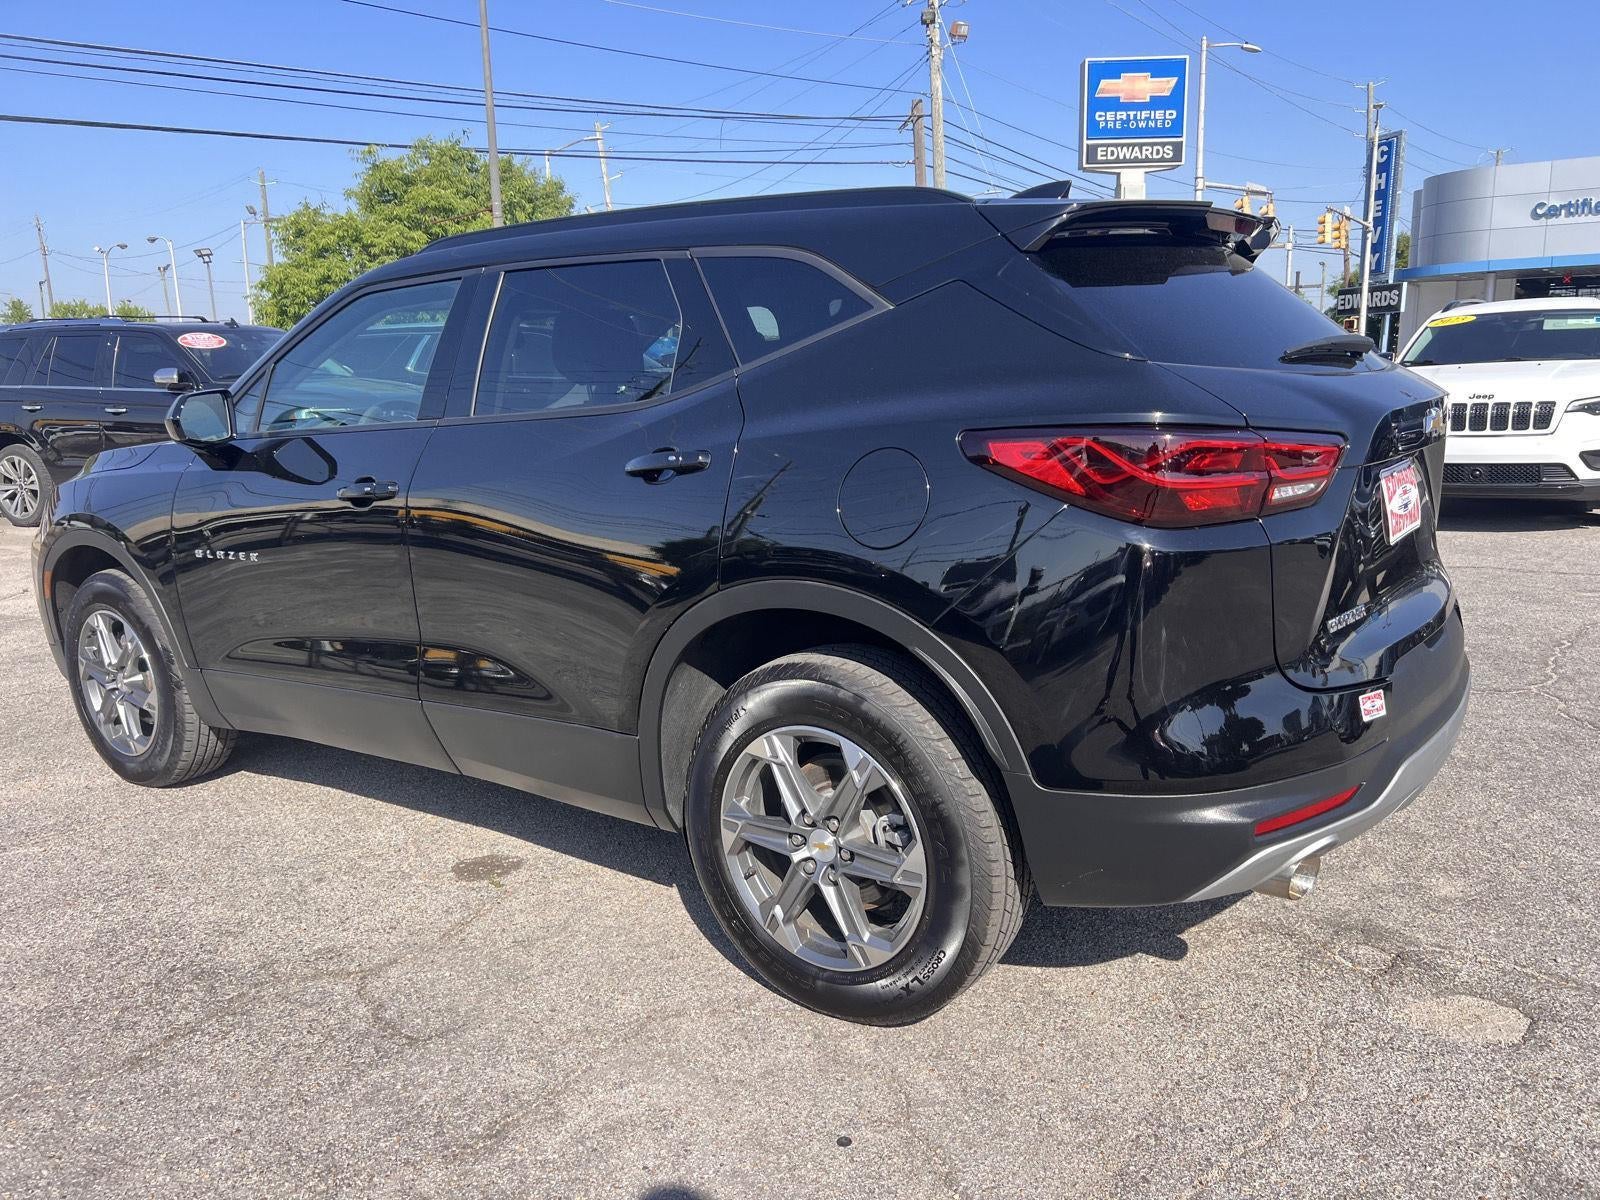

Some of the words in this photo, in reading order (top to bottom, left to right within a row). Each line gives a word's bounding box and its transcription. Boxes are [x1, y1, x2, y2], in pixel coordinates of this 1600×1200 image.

[1095, 110, 1177, 121] CERTIFIED
[1099, 120, 1172, 129] PRE-OWNED
[1097, 145, 1174, 160] EDWARDS
[1369, 145, 1389, 271] CHEVY
[194, 549, 259, 562] BLAZER
[922, 949, 946, 981] CROSS
[900, 975, 925, 998] LX
